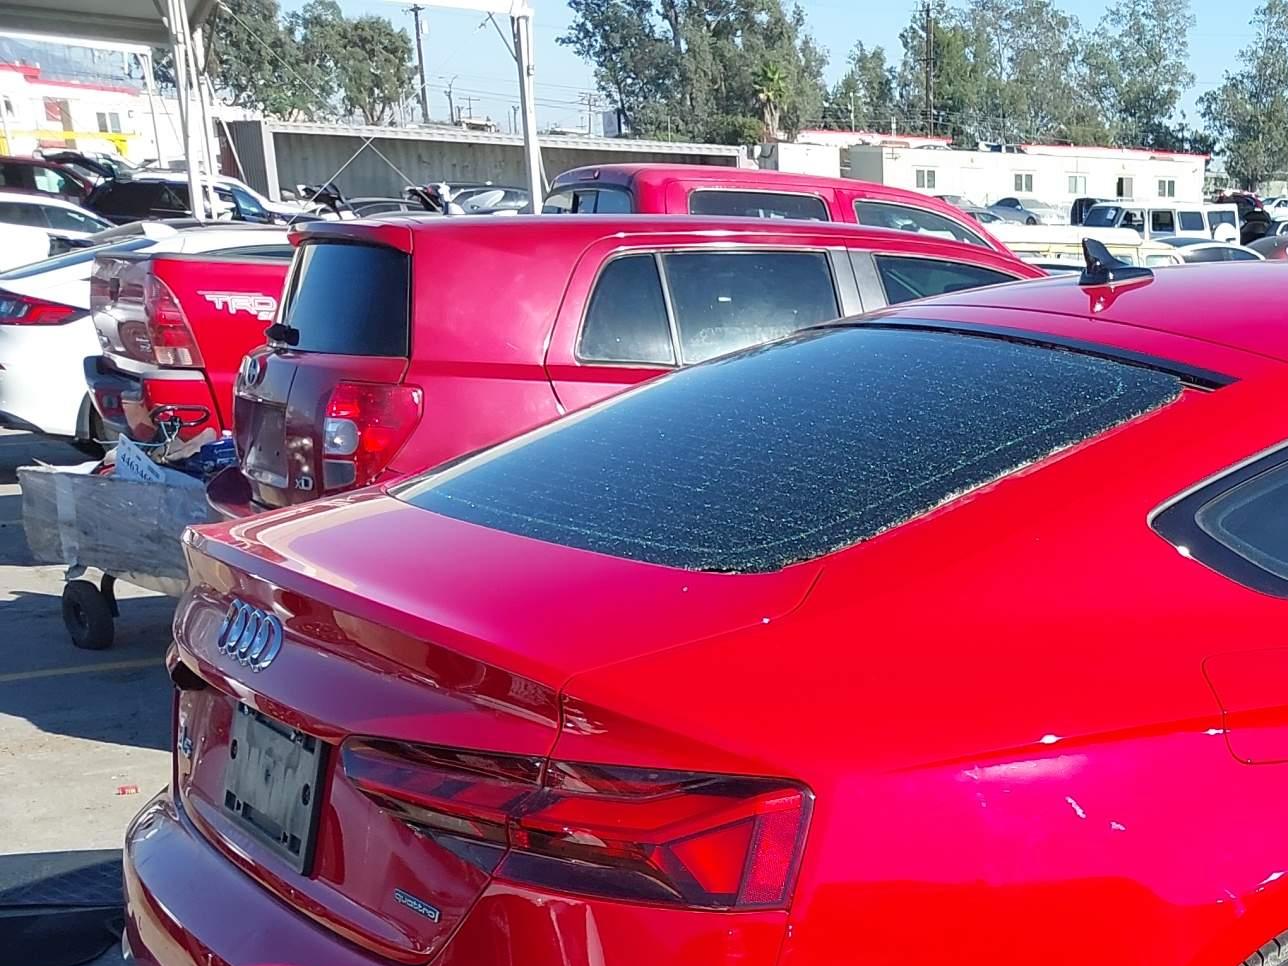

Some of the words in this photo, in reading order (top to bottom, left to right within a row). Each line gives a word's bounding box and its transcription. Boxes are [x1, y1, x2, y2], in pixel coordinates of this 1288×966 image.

[204, 294, 277, 315] TRD
[294, 476, 313, 491] xD
[395, 892, 436, 919] quattro
